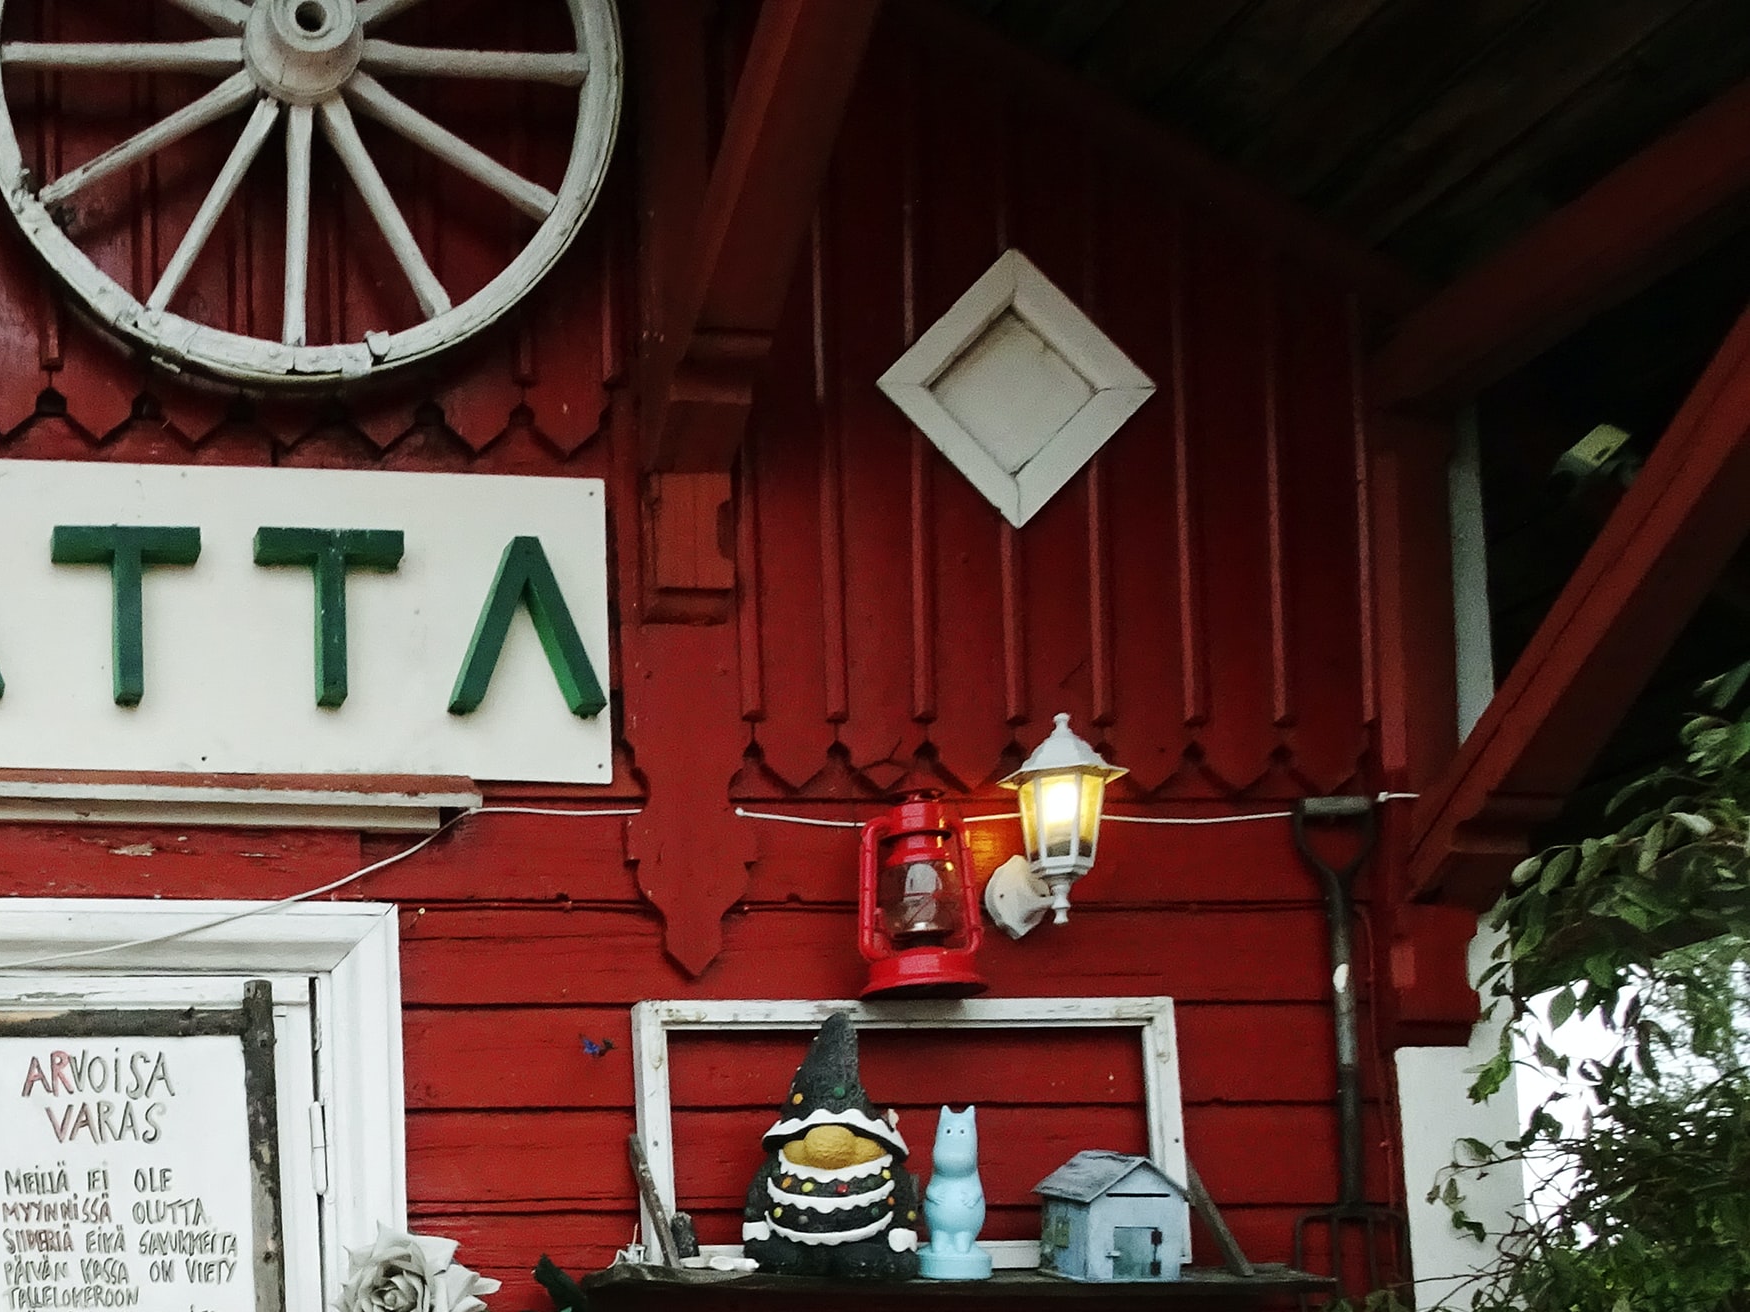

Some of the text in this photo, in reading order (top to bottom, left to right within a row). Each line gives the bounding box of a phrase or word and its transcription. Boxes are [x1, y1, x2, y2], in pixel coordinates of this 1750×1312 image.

[21, 1047, 176, 1100] ARVOISA
[45, 1100, 167, 1145] VARAS
[4, 1160, 70, 1196] MEILLÄ
[134, 1167, 173, 1193] OLE
[2, 1193, 113, 1224] MYYNNISSÄ
[2, 1224, 238, 1256] SIIDERIÄ EIKÄ SAVUKKEITA
[3, 1255, 238, 1285] PÄIVÄN KASSA ON VIETY
